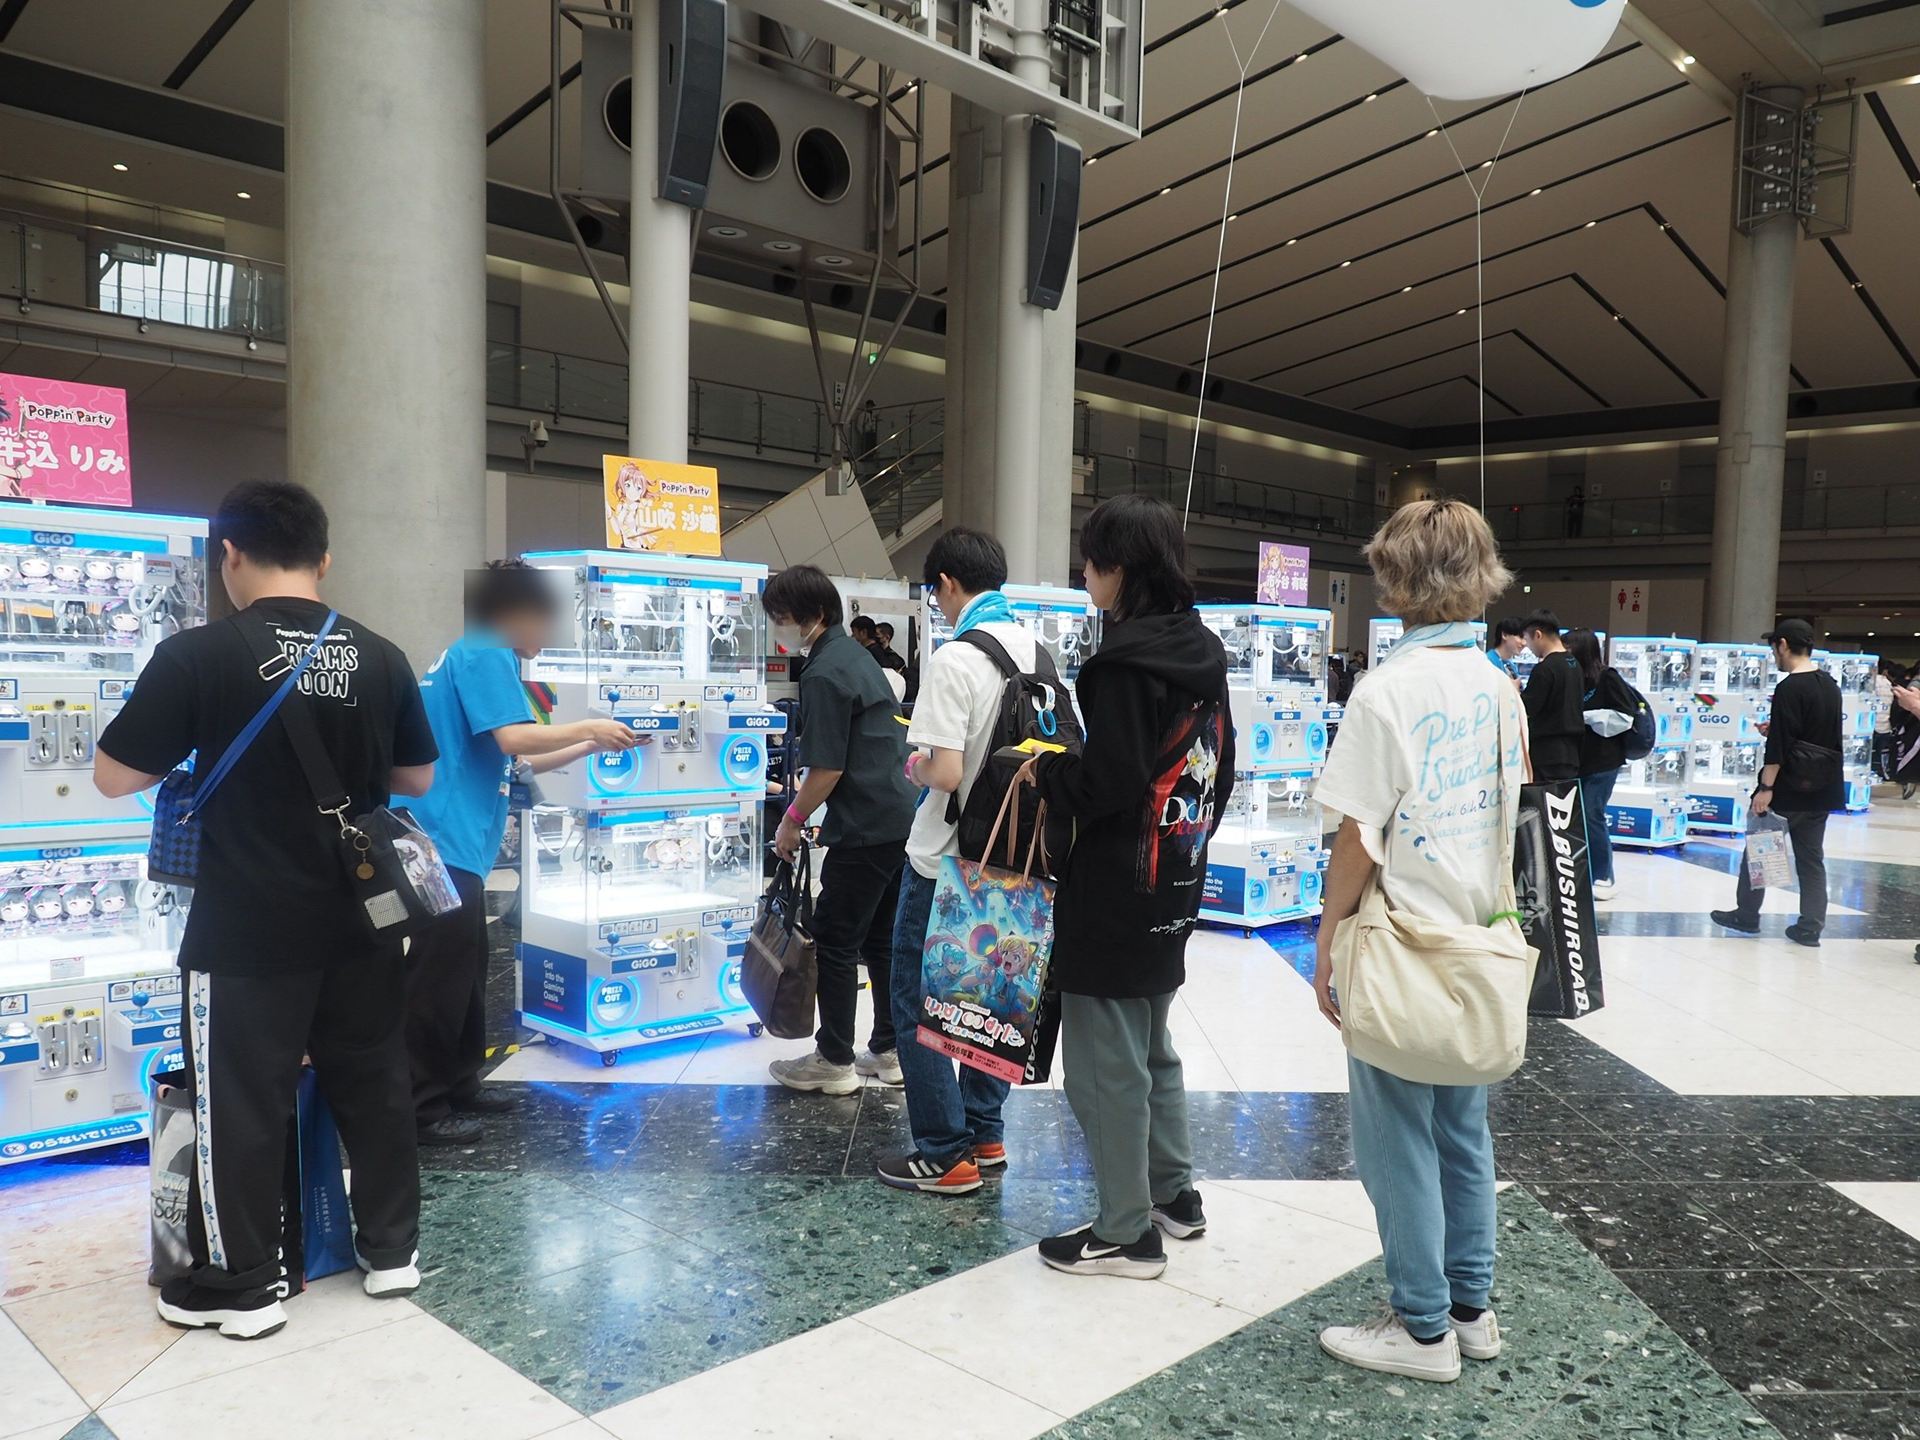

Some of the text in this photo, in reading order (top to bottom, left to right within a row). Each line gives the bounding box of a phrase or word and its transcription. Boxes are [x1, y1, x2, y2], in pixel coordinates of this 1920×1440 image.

[77, 410, 112, 426] Party
[0, 436, 126, 474] 牛込 りみ
[34, 532, 74, 545] GiGO
[632, 717, 660, 729] GiGO
[746, 717, 770, 727] GiGO
[1699, 714, 1730, 724] GiGO
[604, 757, 622, 766] OUT
[735, 754, 750, 763] OUT
[42, 846, 81, 858] GiGO
[1552, 832, 1590, 1013] BUSHIROAD
[543, 959, 553, 971] Get
[631, 957, 658, 969] GiGO
[543, 980, 565, 996] Gaming
[601, 986, 623, 996] PRIZE
[604, 994, 621, 1004] OUT
[163, 1026, 180, 1038] Gi
[163, 1054, 184, 1065] PRI
